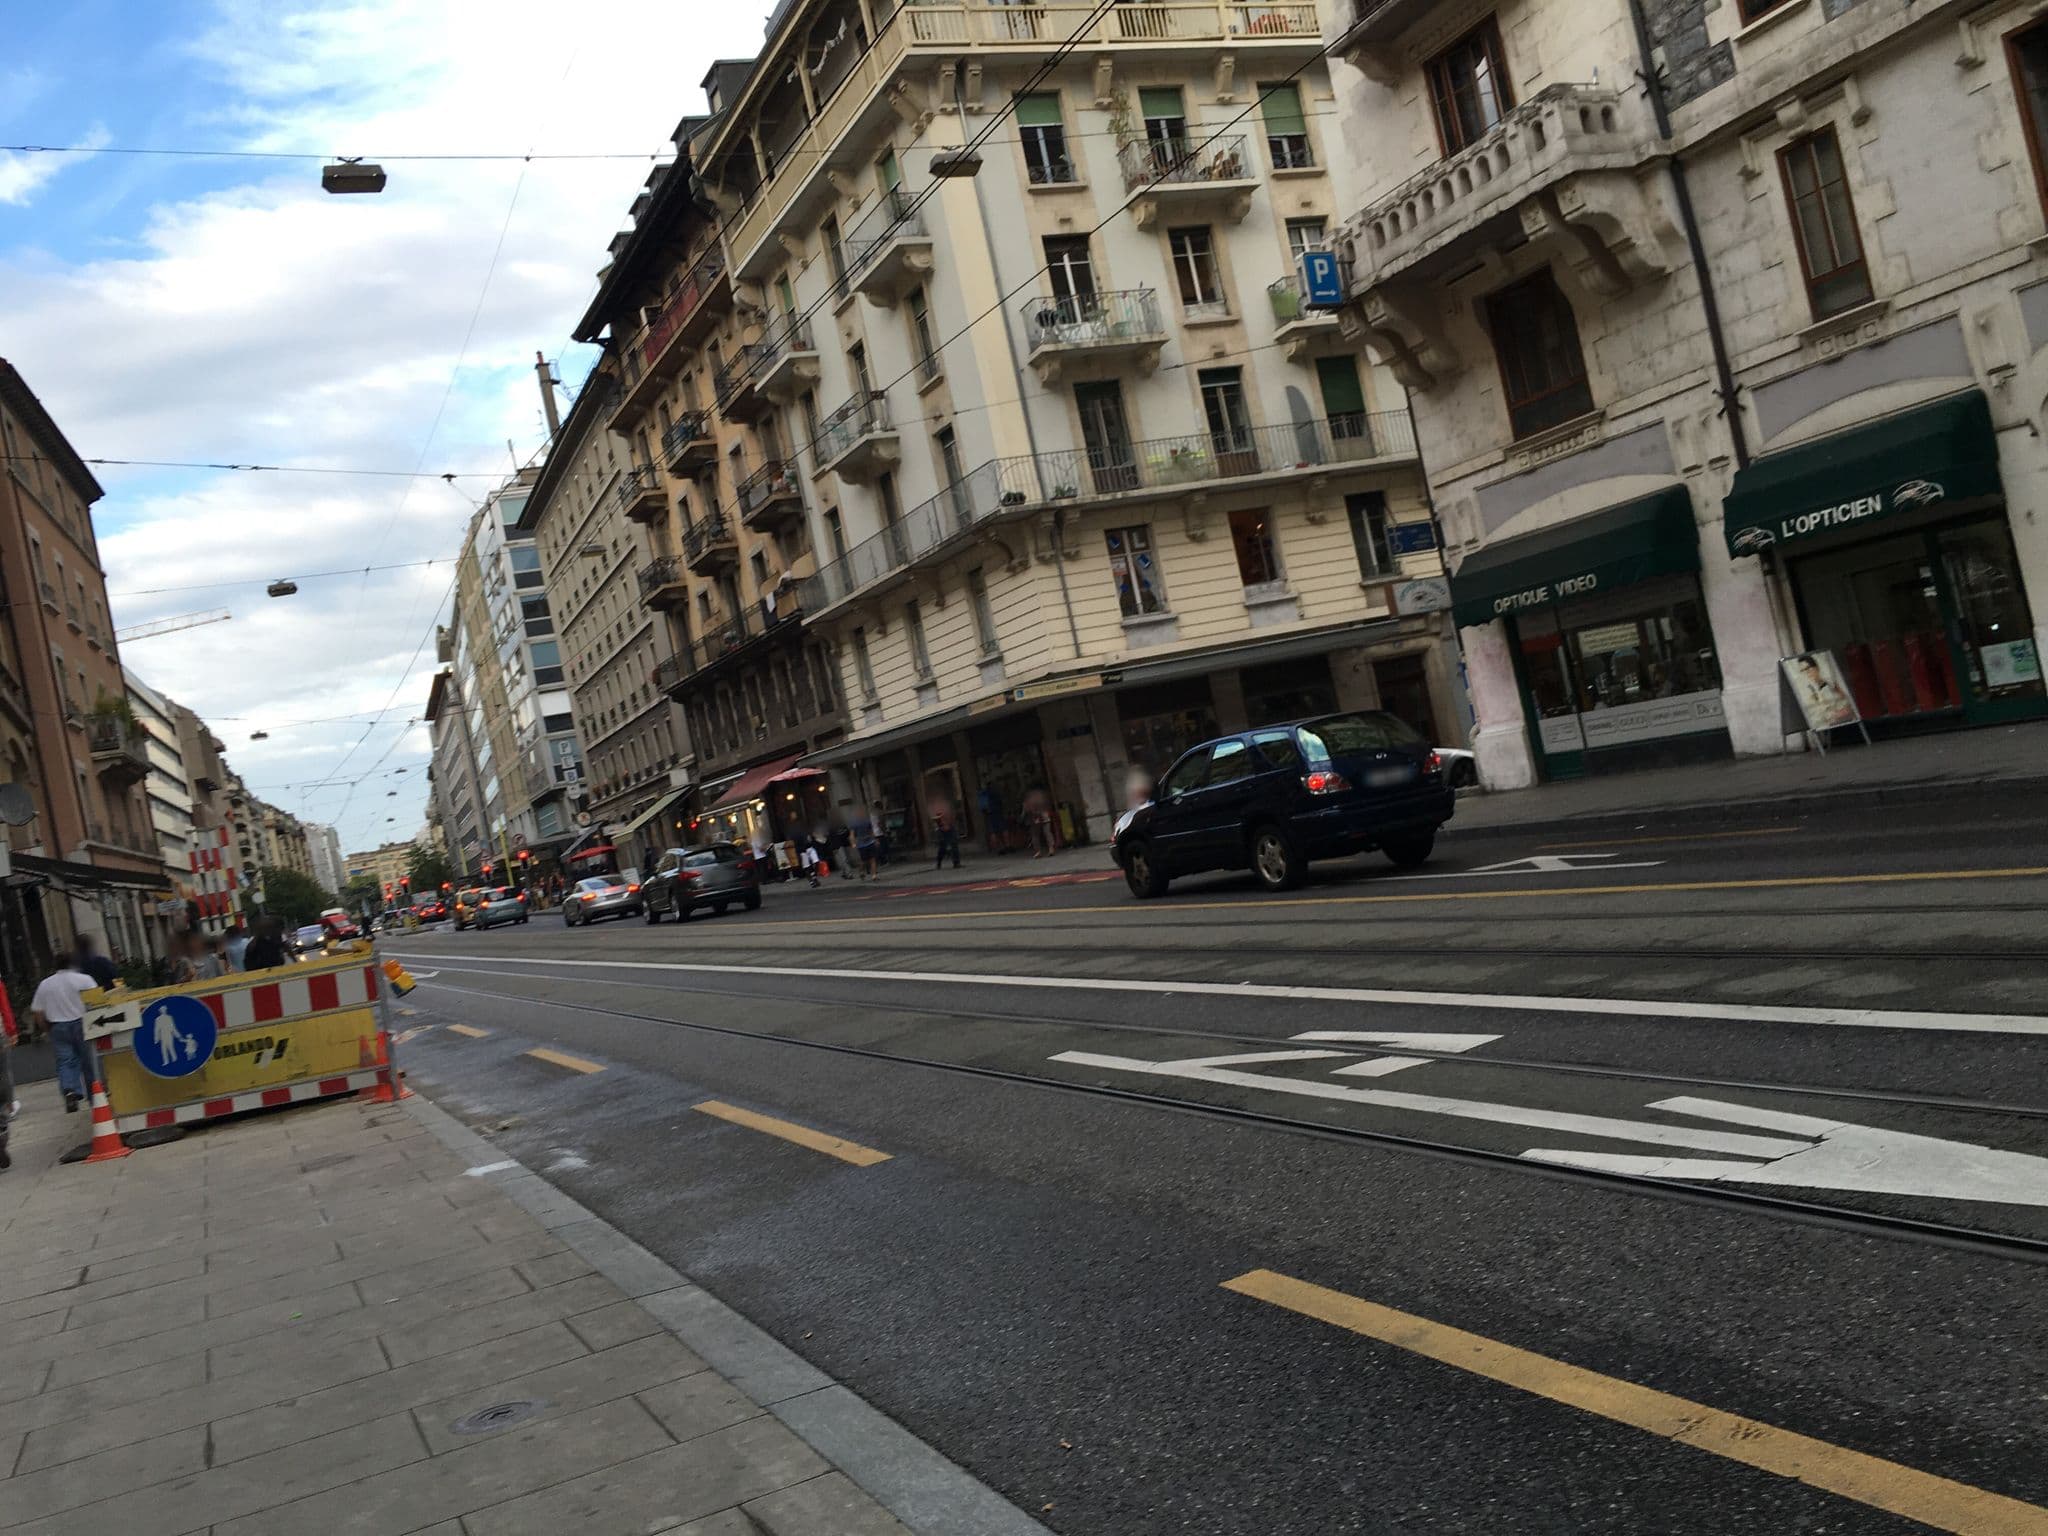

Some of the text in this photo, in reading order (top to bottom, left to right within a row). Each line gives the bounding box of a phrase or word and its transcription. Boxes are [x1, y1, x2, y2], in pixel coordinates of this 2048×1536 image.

[1313, 258, 1329, 284] P
[1781, 494, 1882, 539] L'OPTICIEN
[1493, 573, 1598, 613] OPTIQUE VIDEO
